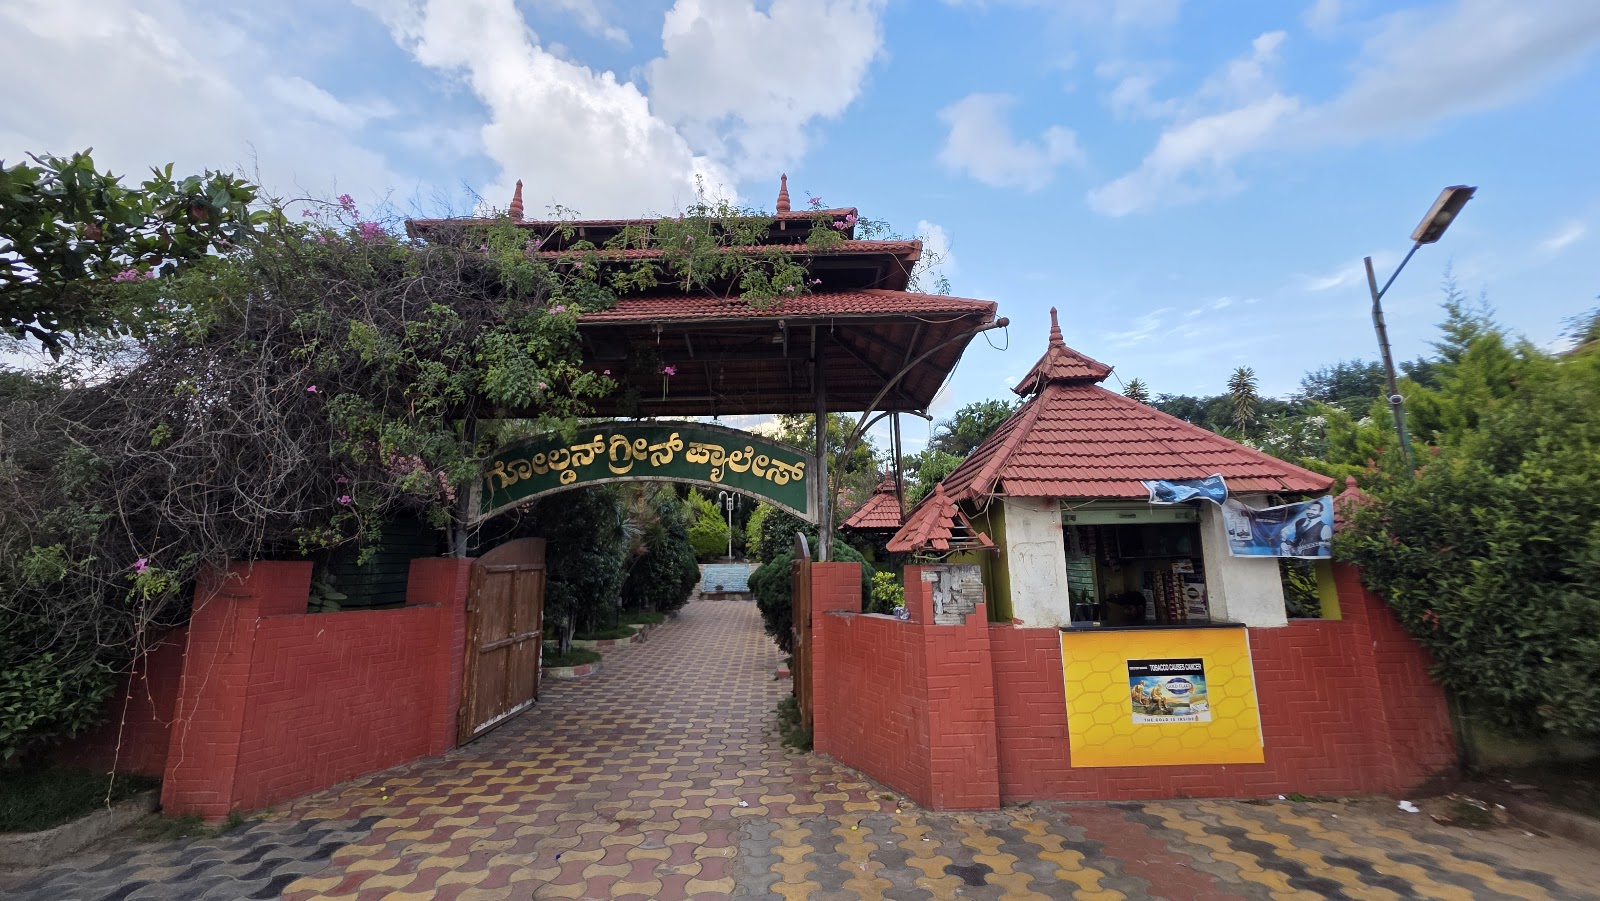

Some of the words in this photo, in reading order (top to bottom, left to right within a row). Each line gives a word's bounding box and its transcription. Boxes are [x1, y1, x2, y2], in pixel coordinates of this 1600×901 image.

[483, 434, 606, 492] ಗೋಲ್ಡನ್
[608, 432, 684, 475] ಗ್ರೀನ್
[685, 441, 806, 486] ಪ್ಯಾಲೇಸ್
[1149, 663, 1169, 672] TOBACCO
[1169, 663, 1185, 671] CAUSES
[1185, 663, 1201, 671] CANCER
